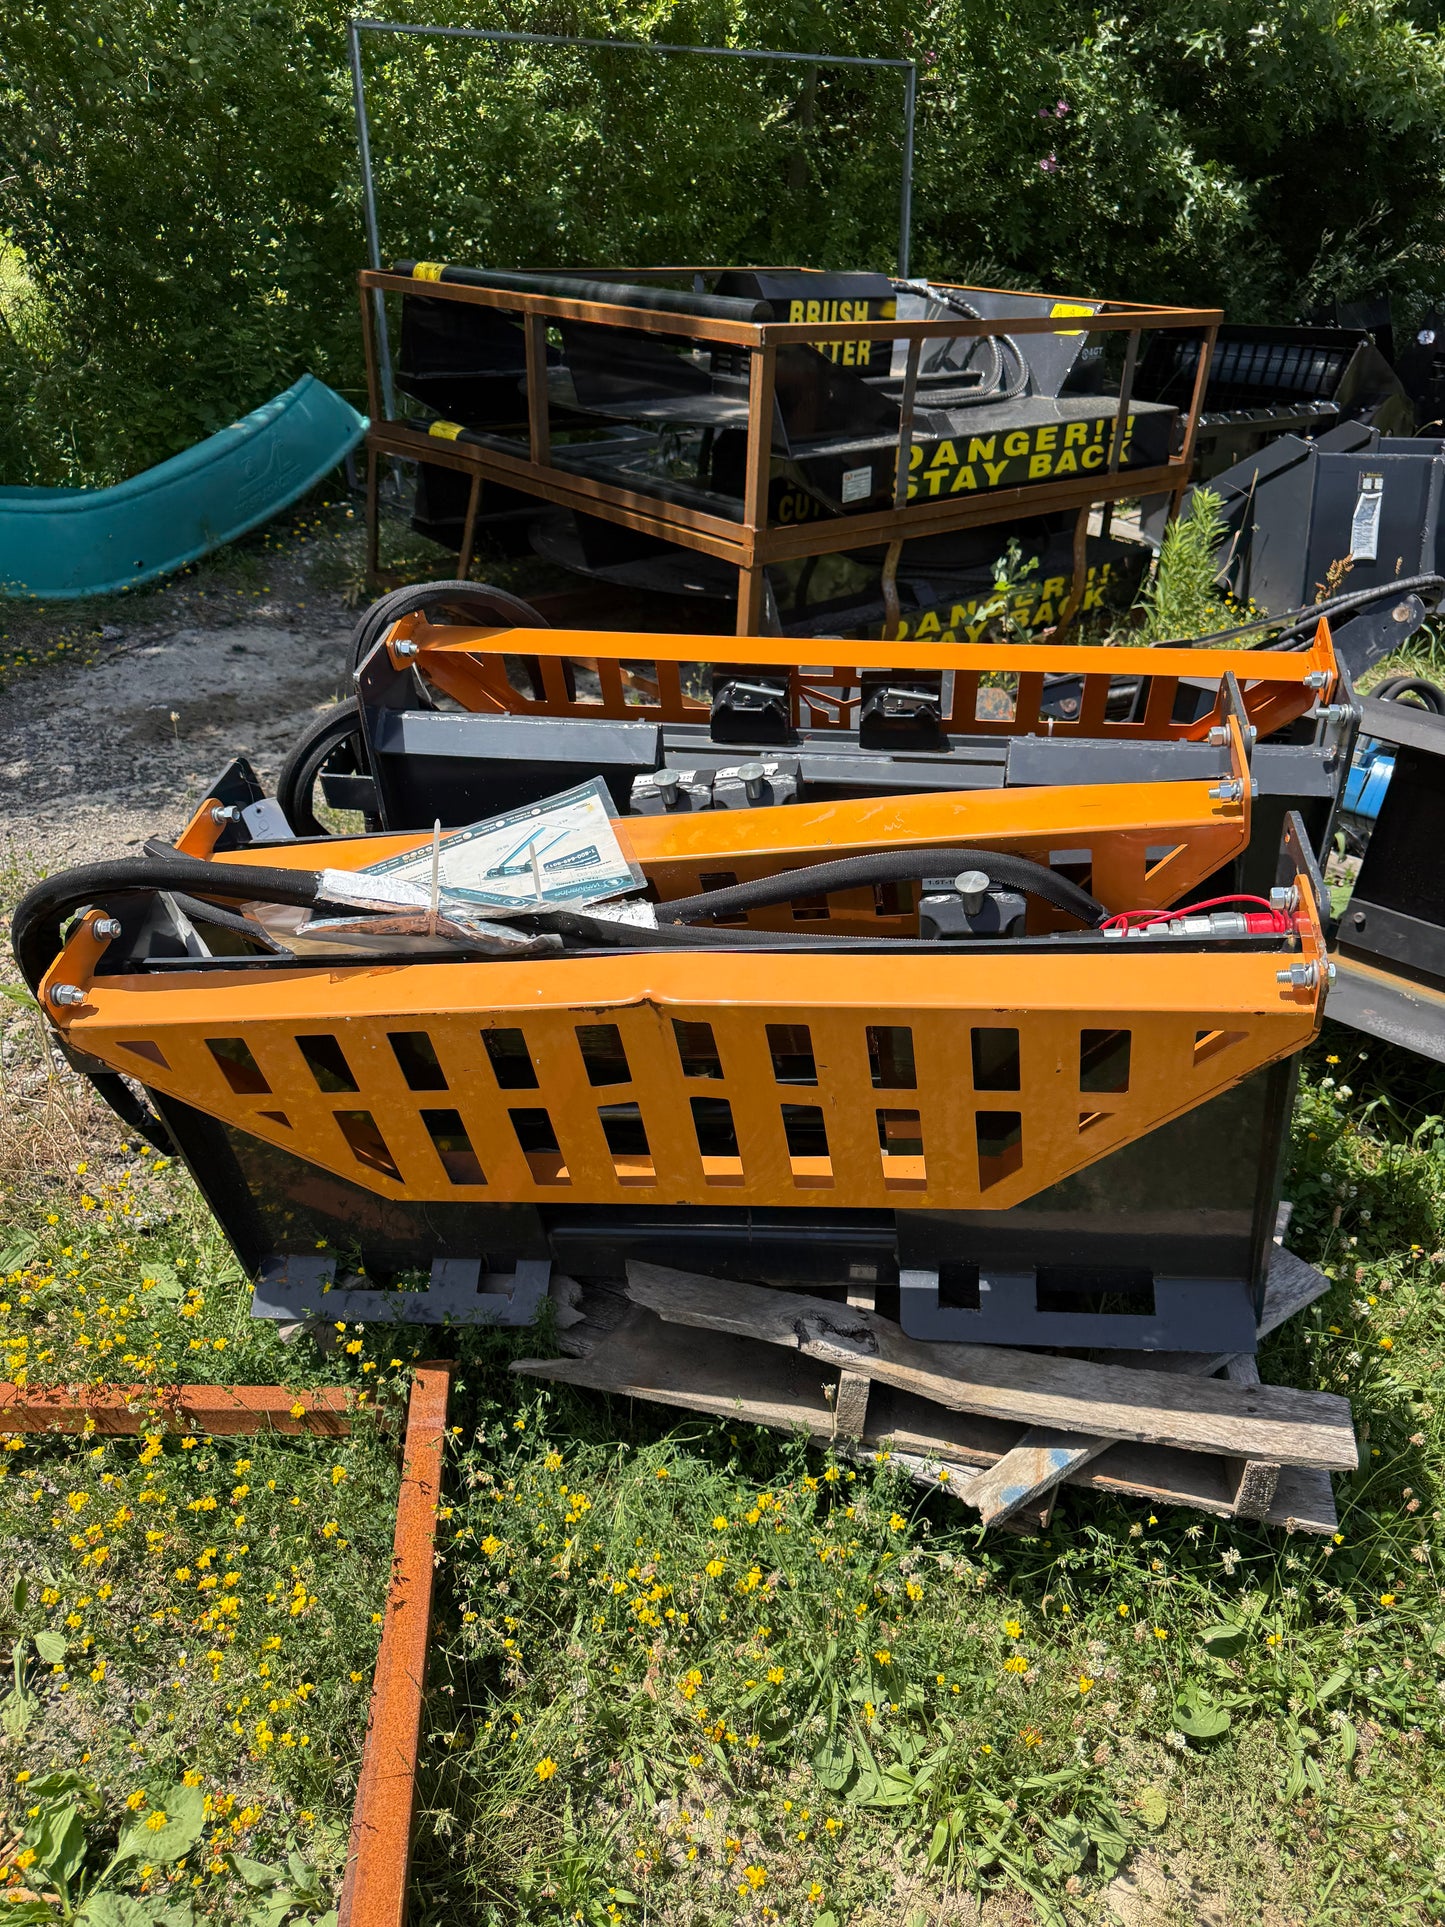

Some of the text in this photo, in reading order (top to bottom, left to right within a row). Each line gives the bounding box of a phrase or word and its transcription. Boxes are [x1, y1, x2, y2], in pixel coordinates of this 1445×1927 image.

[789, 300, 869, 323] BRUSH
[808, 340, 871, 365] TTER
[892, 459, 1010, 501] STAY
[1028, 440, 1131, 480] BACK
